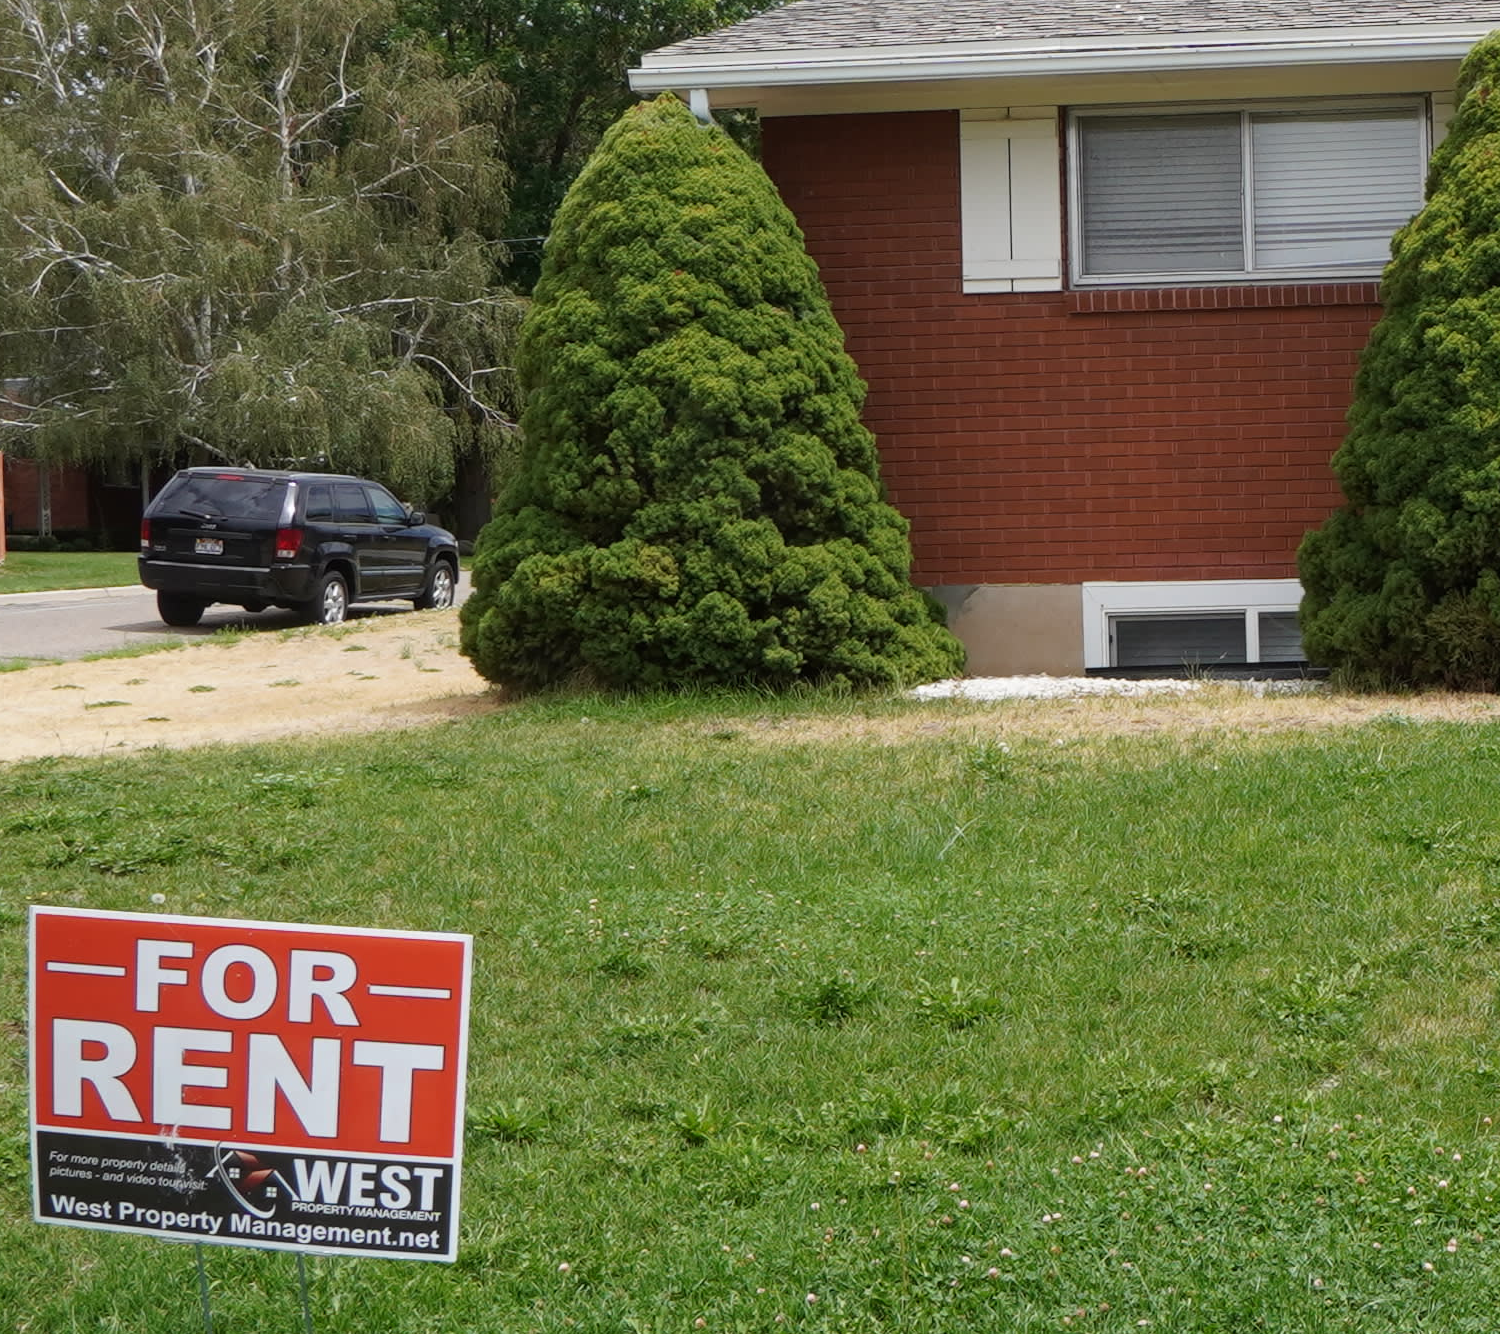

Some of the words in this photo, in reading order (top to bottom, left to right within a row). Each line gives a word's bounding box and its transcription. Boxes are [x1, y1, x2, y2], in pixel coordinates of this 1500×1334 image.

[135, 939, 361, 1027] FOR
[52, 1017, 445, 1144] RENT
[49, 1150, 69, 1163] For
[71, 1154, 99, 1166] more
[101, 1157, 148, 1173] property
[150, 1159, 187, 1174] details
[49, 1166, 93, 1179] pictures
[102, 1171, 124, 1183] and
[127, 1174, 157, 1186] video
[158, 1178, 182, 1189] tour
[293, 1158, 444, 1211] WEST
[51, 1194, 112, 1218] West
[119, 1202, 223, 1235] Property
[230, 1213, 440, 1249] Management.net
[292, 1201, 354, 1216] PROPERTY
[355, 1208, 442, 1222] MANAGEMENT
